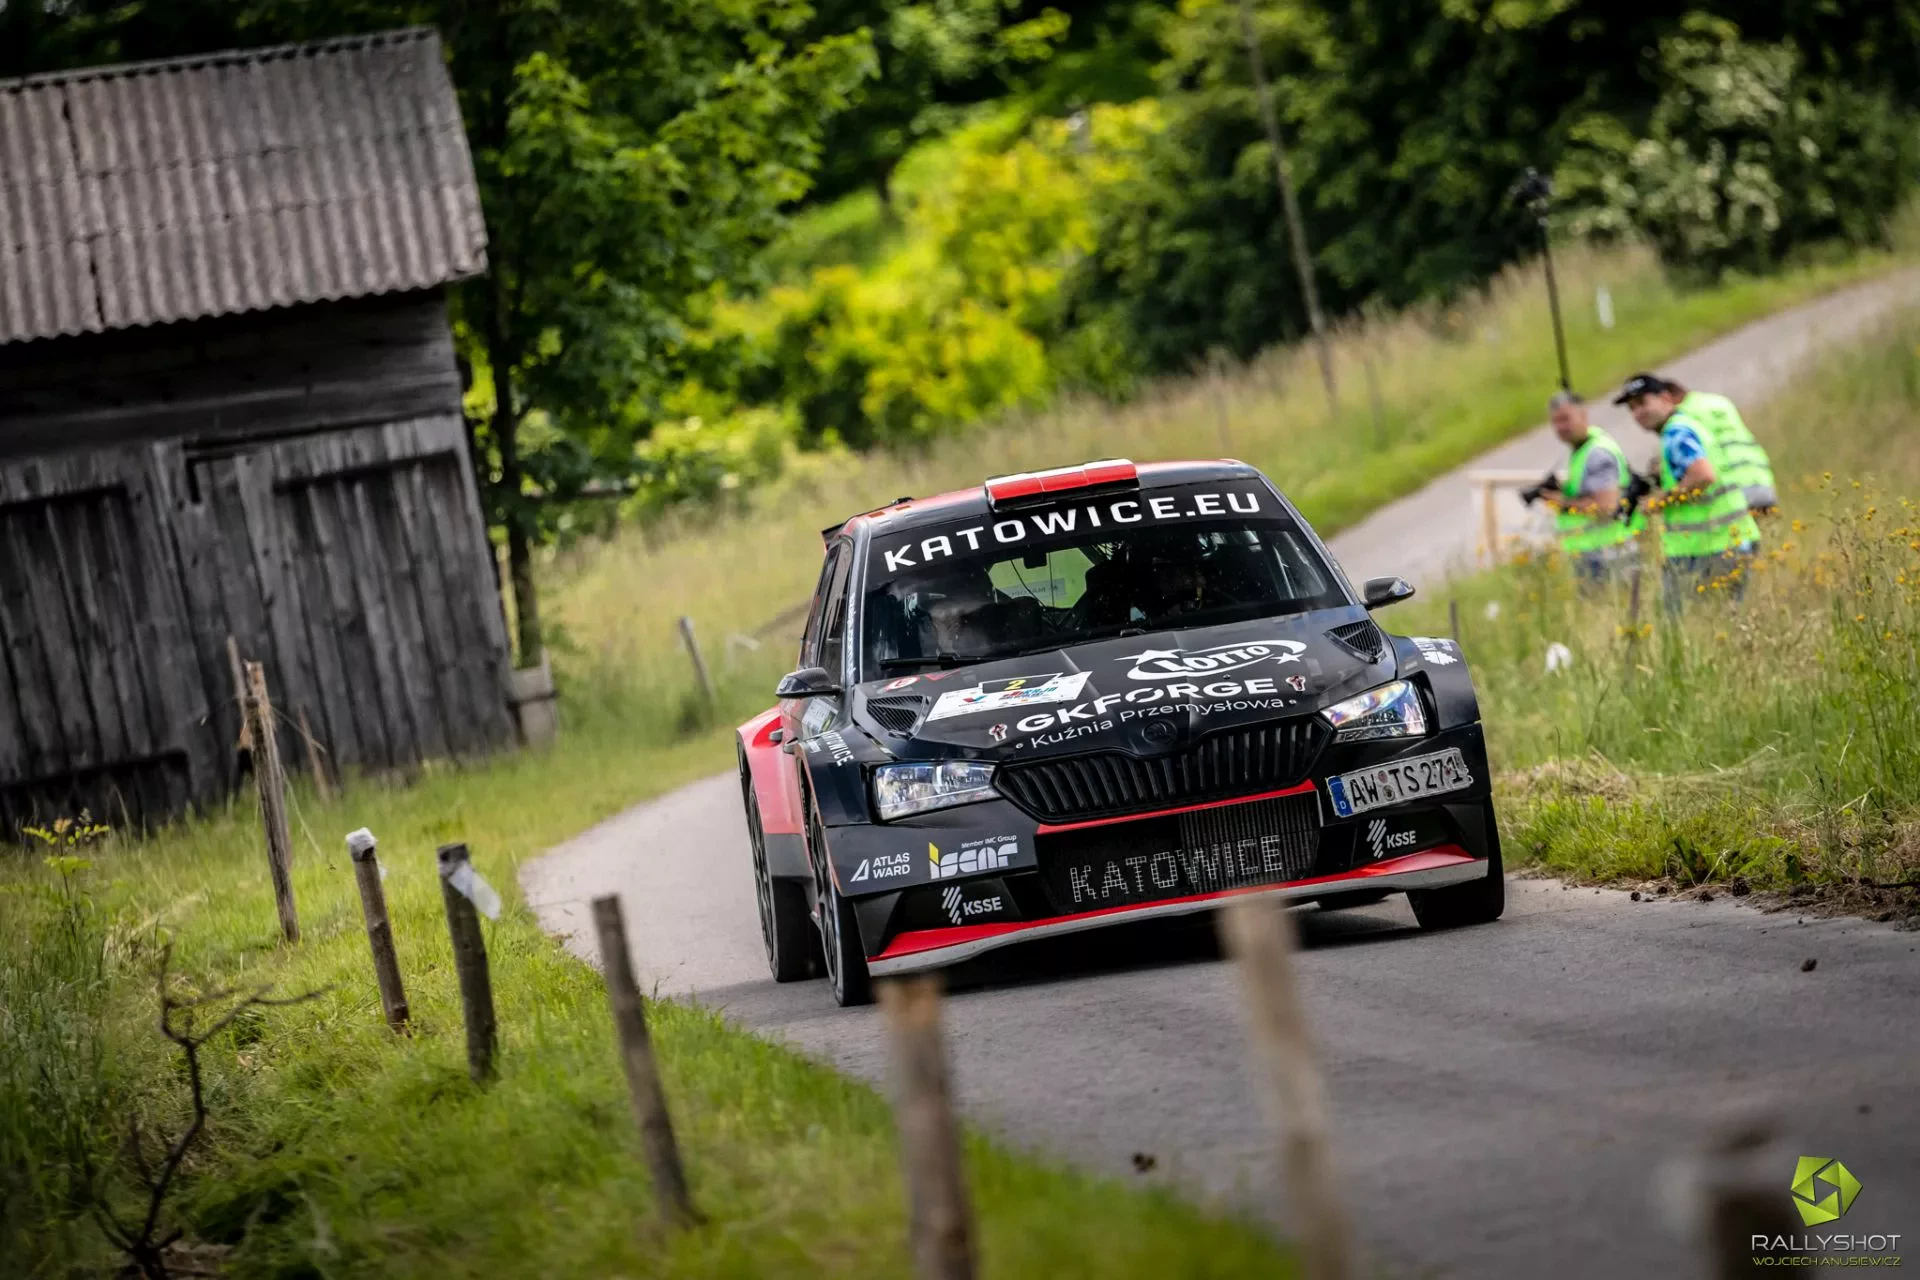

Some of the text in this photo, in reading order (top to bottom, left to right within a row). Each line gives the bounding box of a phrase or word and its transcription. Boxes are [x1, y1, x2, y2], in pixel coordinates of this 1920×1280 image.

[884, 493, 1261, 573] KATOWICE.EU
[1152, 645, 1271, 673] LOTTO
[1004, 679, 1027, 691] 2
[1016, 678, 1279, 733] GKFORGE
[1031, 696, 1285, 749] Kuźnia Przemysłowa
[1351, 774, 1380, 808] AW
[1386, 830, 1417, 849] KSSE
[873, 852, 911, 868] ATLAS
[873, 864, 911, 880] WARD
[1070, 835, 1283, 902] KATOWICE
[963, 896, 1003, 916] KSSE
